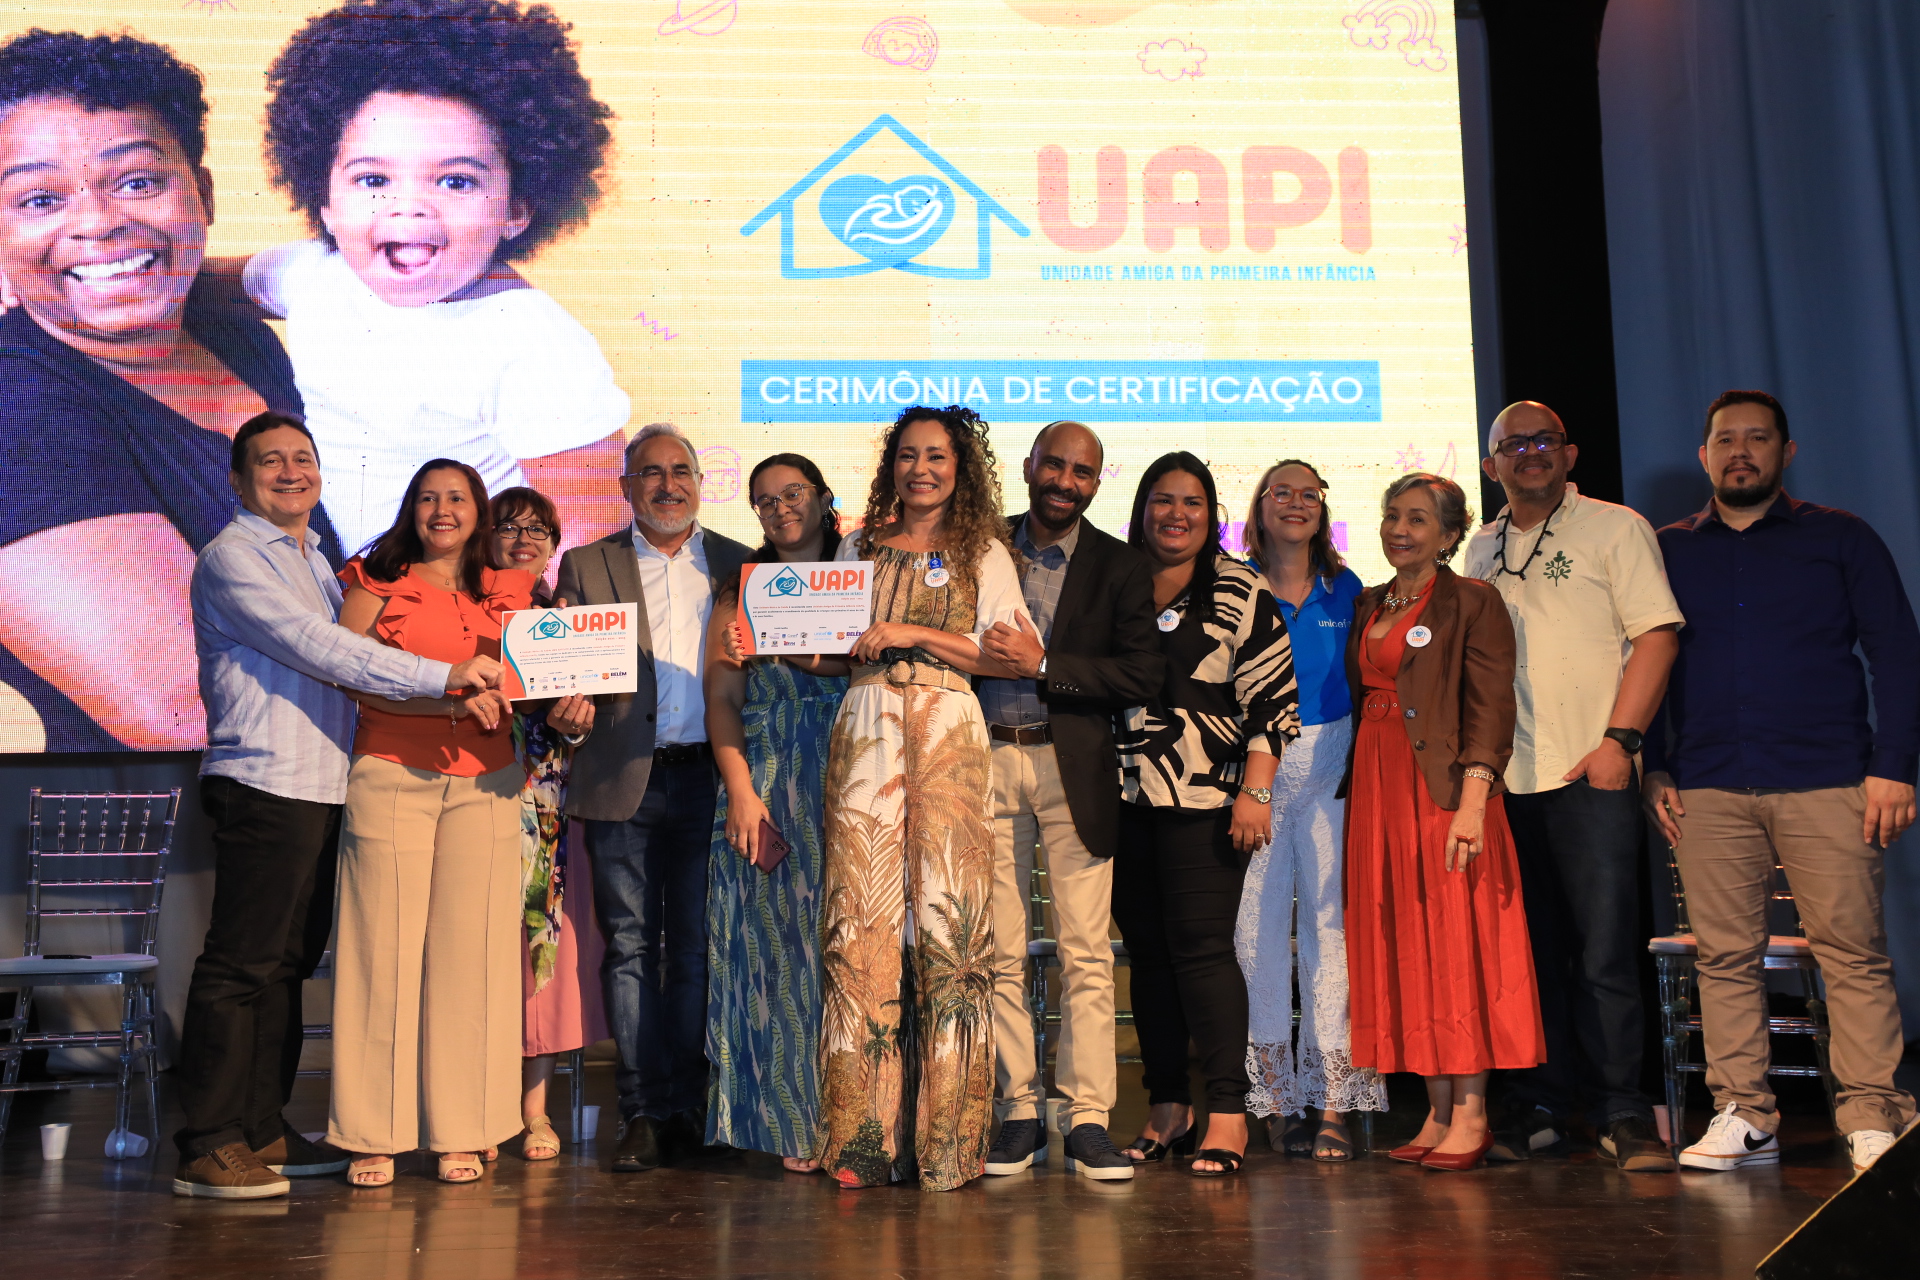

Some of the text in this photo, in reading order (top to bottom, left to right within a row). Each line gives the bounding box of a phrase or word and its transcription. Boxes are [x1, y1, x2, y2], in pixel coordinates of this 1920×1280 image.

[1037, 144, 1372, 254] UAPI
[1041, 263, 1376, 281] UNIDADE AMIGA DA PRIMEIRA INFÂNCIA
[760, 370, 1363, 413] CERIMÔNIA DE CERTIFICAÇÃO
[810, 570, 864, 591] UAPI
[573, 611, 626, 632] UAPI
